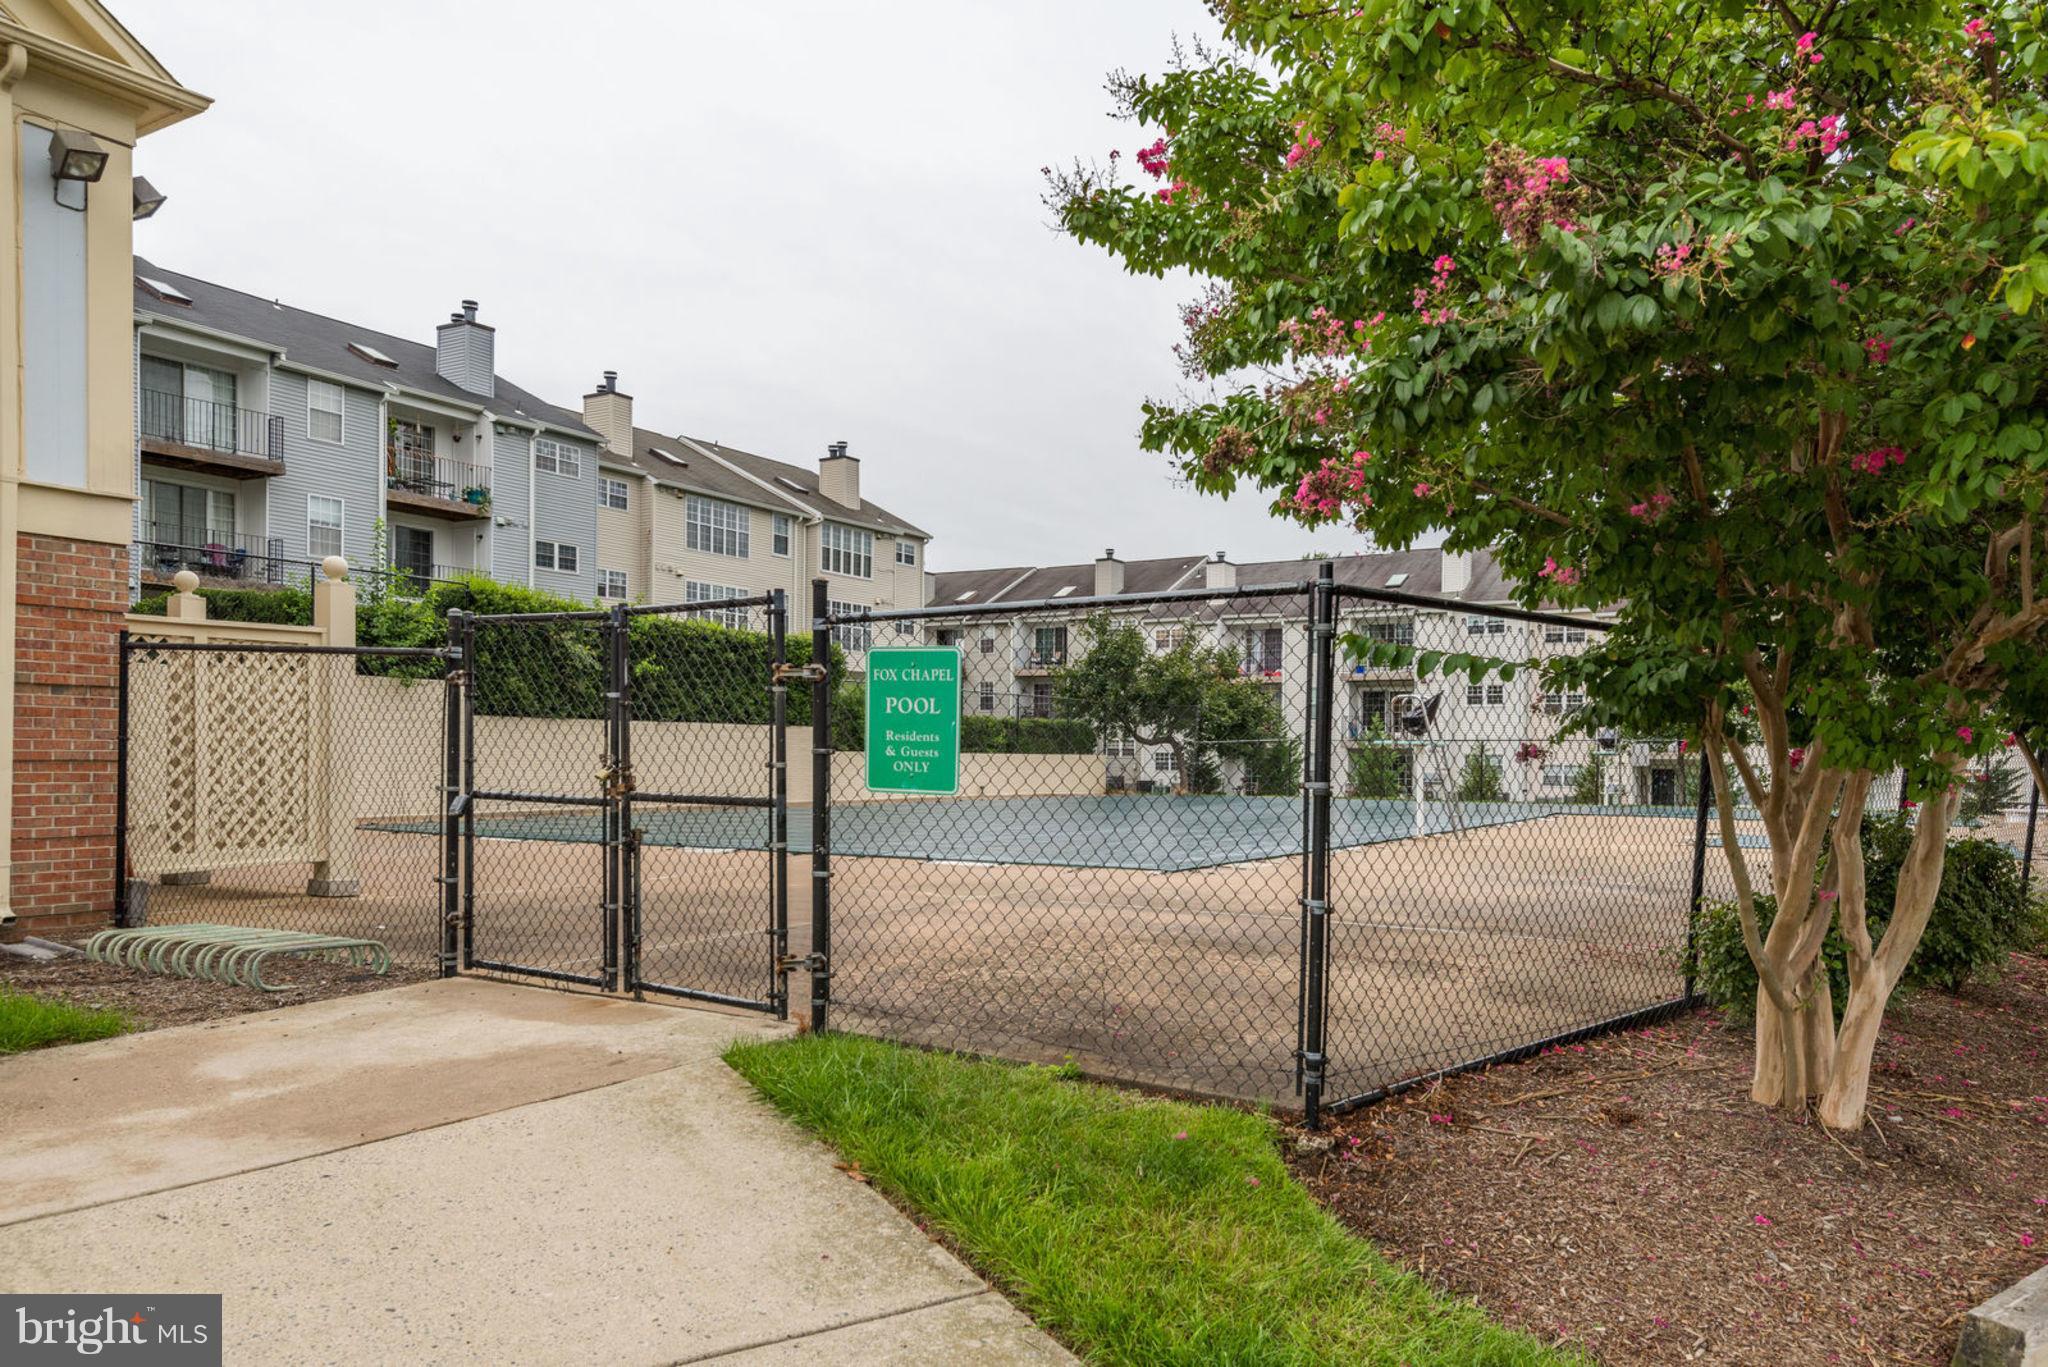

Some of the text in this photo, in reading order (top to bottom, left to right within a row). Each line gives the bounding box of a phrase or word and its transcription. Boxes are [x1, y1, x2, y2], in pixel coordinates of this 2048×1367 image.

[873, 668, 954, 682] FOX CHAPEL
[885, 697, 941, 715] POOL
[885, 730, 940, 742] Residents
[885, 746, 940, 758] & Guests
[893, 761, 930, 773] ONLY
